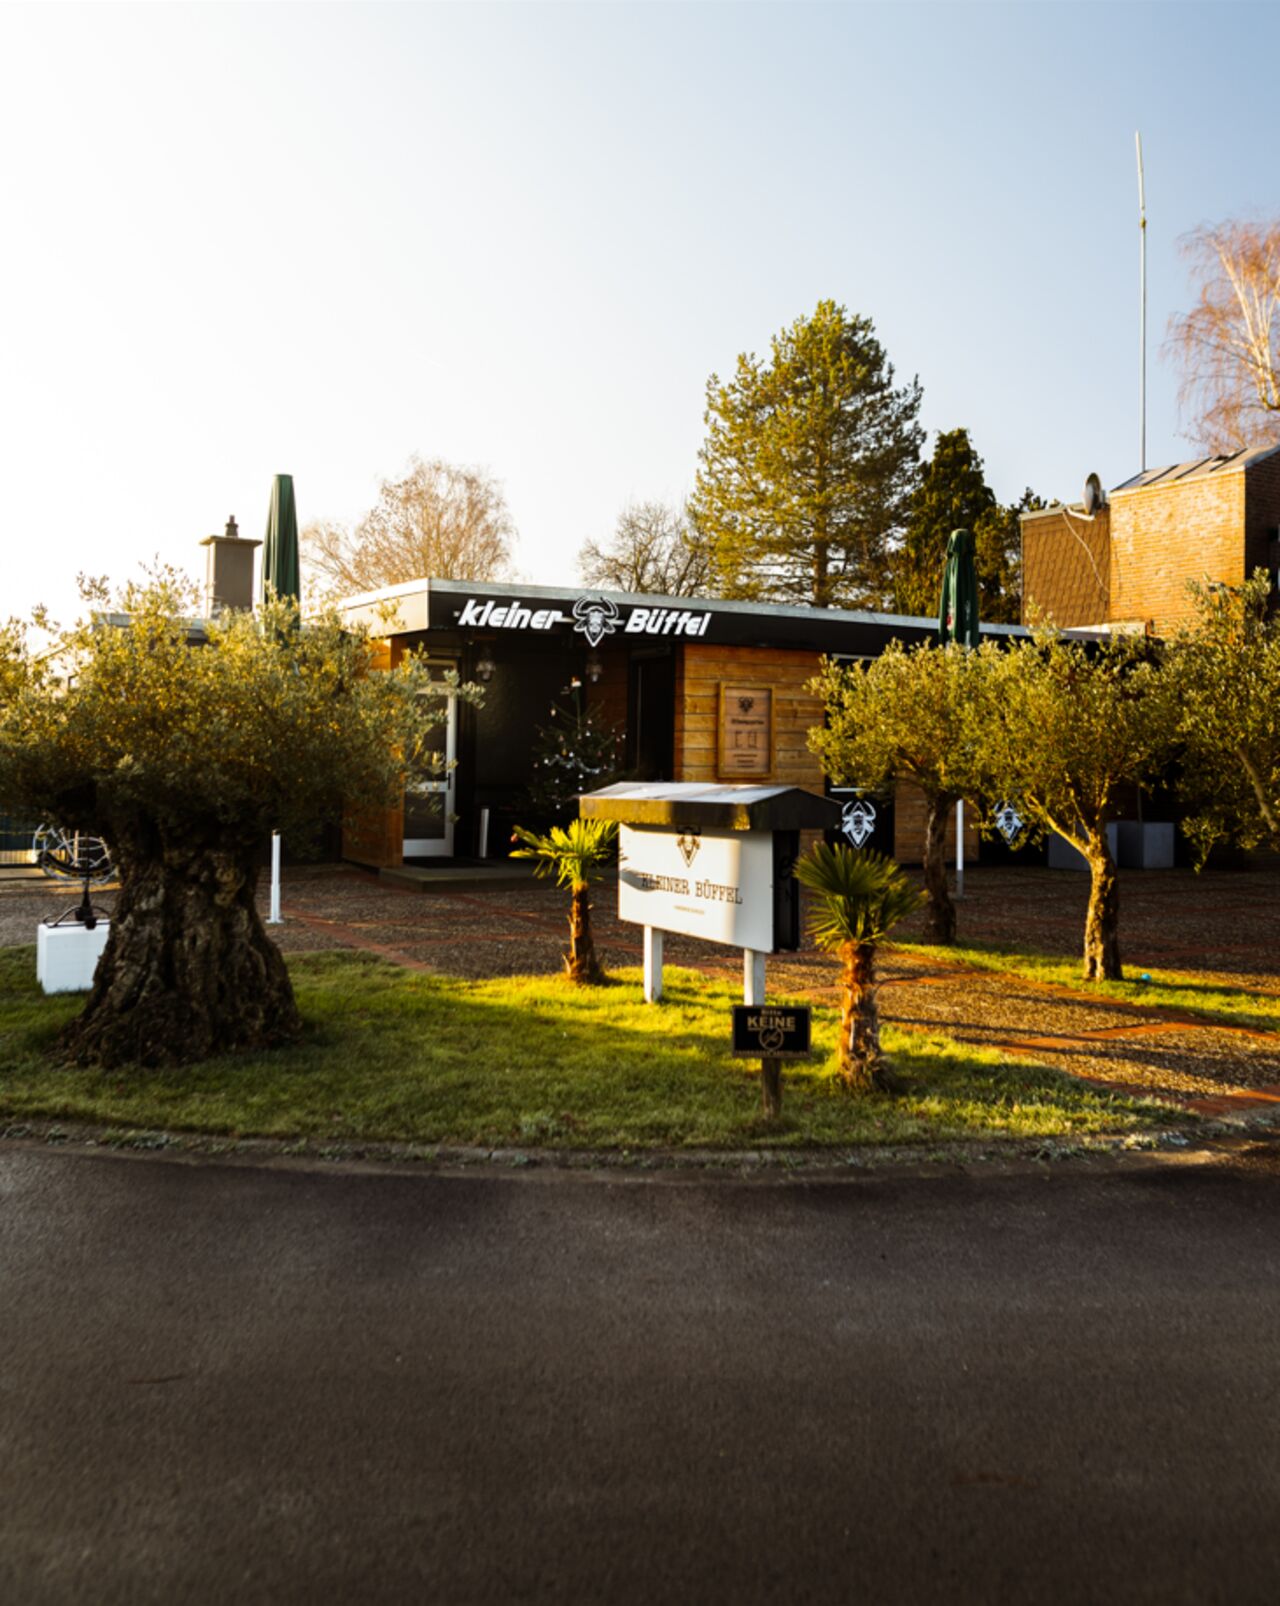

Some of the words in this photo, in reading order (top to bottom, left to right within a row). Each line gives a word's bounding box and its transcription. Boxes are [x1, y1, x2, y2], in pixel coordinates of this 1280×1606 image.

[624, 608, 712, 636] Büffel
[640, 873, 690, 896] KLEINER
[695, 878, 743, 905] BÜFFEL
[747, 1016, 796, 1027] KEINE
